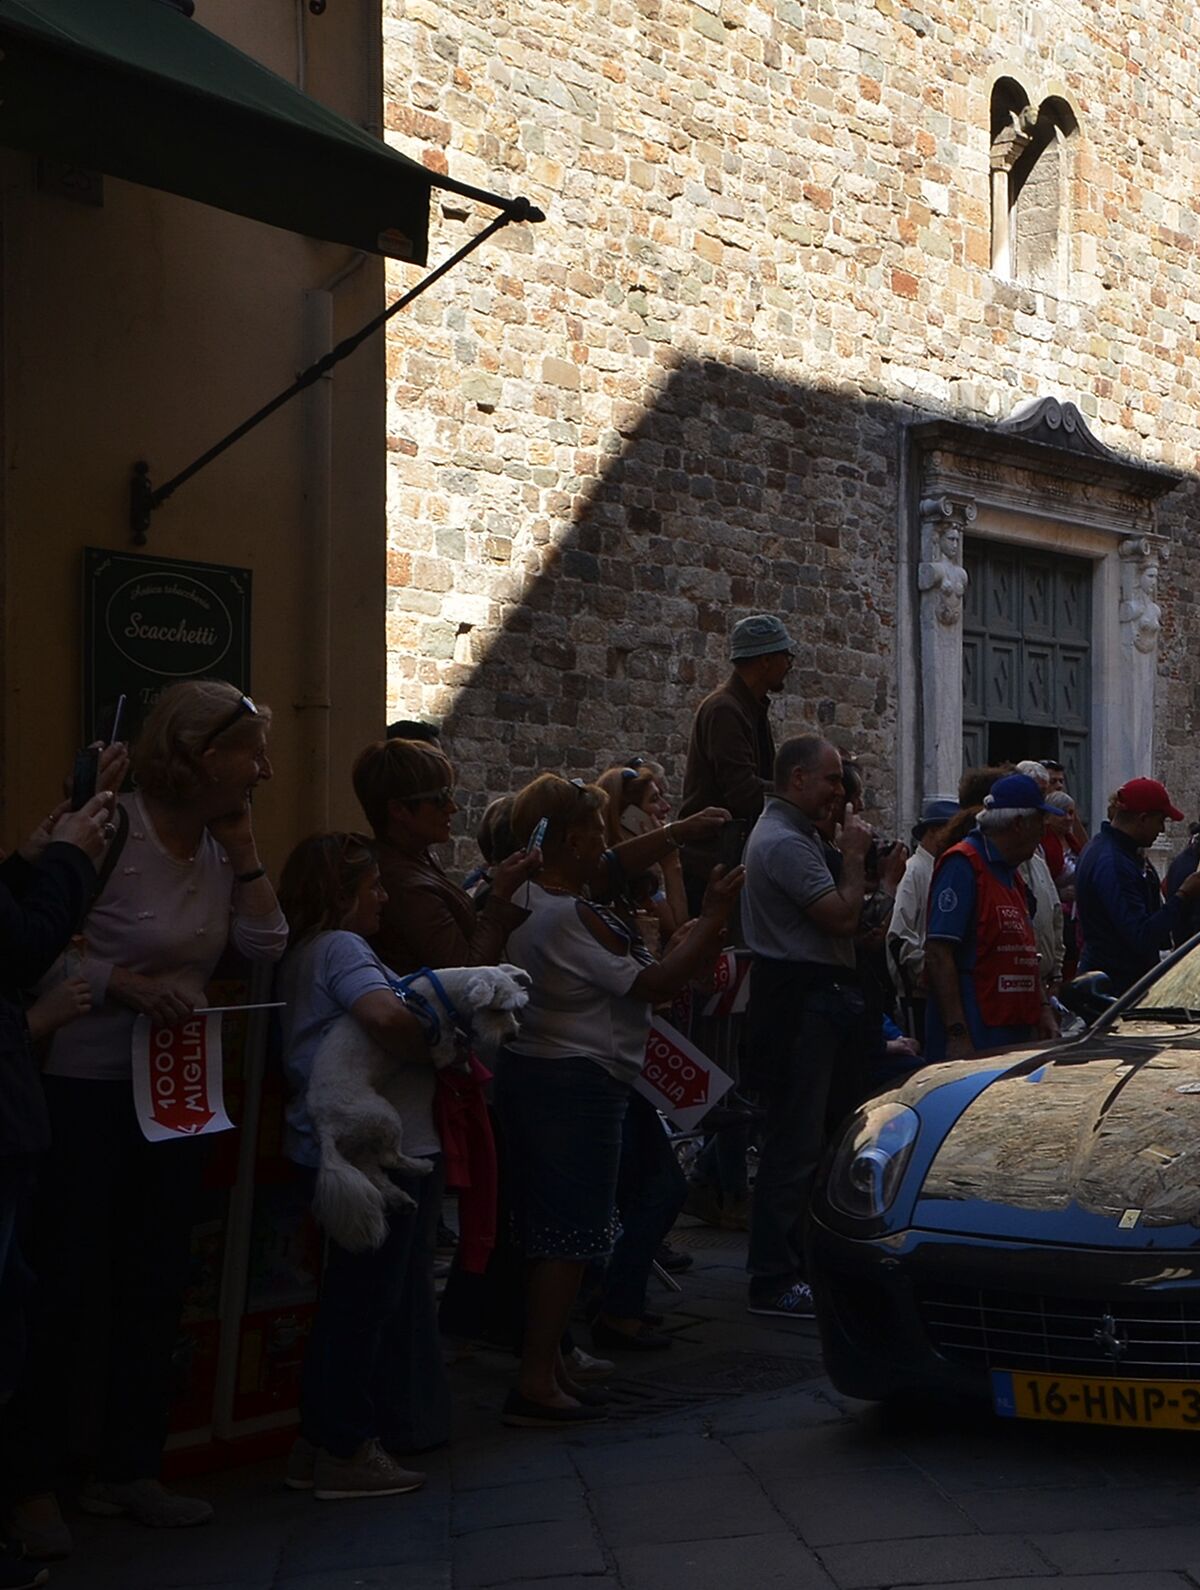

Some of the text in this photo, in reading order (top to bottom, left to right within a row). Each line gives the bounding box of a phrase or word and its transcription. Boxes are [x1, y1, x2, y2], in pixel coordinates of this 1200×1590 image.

[125, 612, 218, 645] Scacchetti
[155, 1028, 176, 1109] 1000
[181, 1020, 205, 1112] MIGLIA
[647, 1036, 697, 1082] 1000
